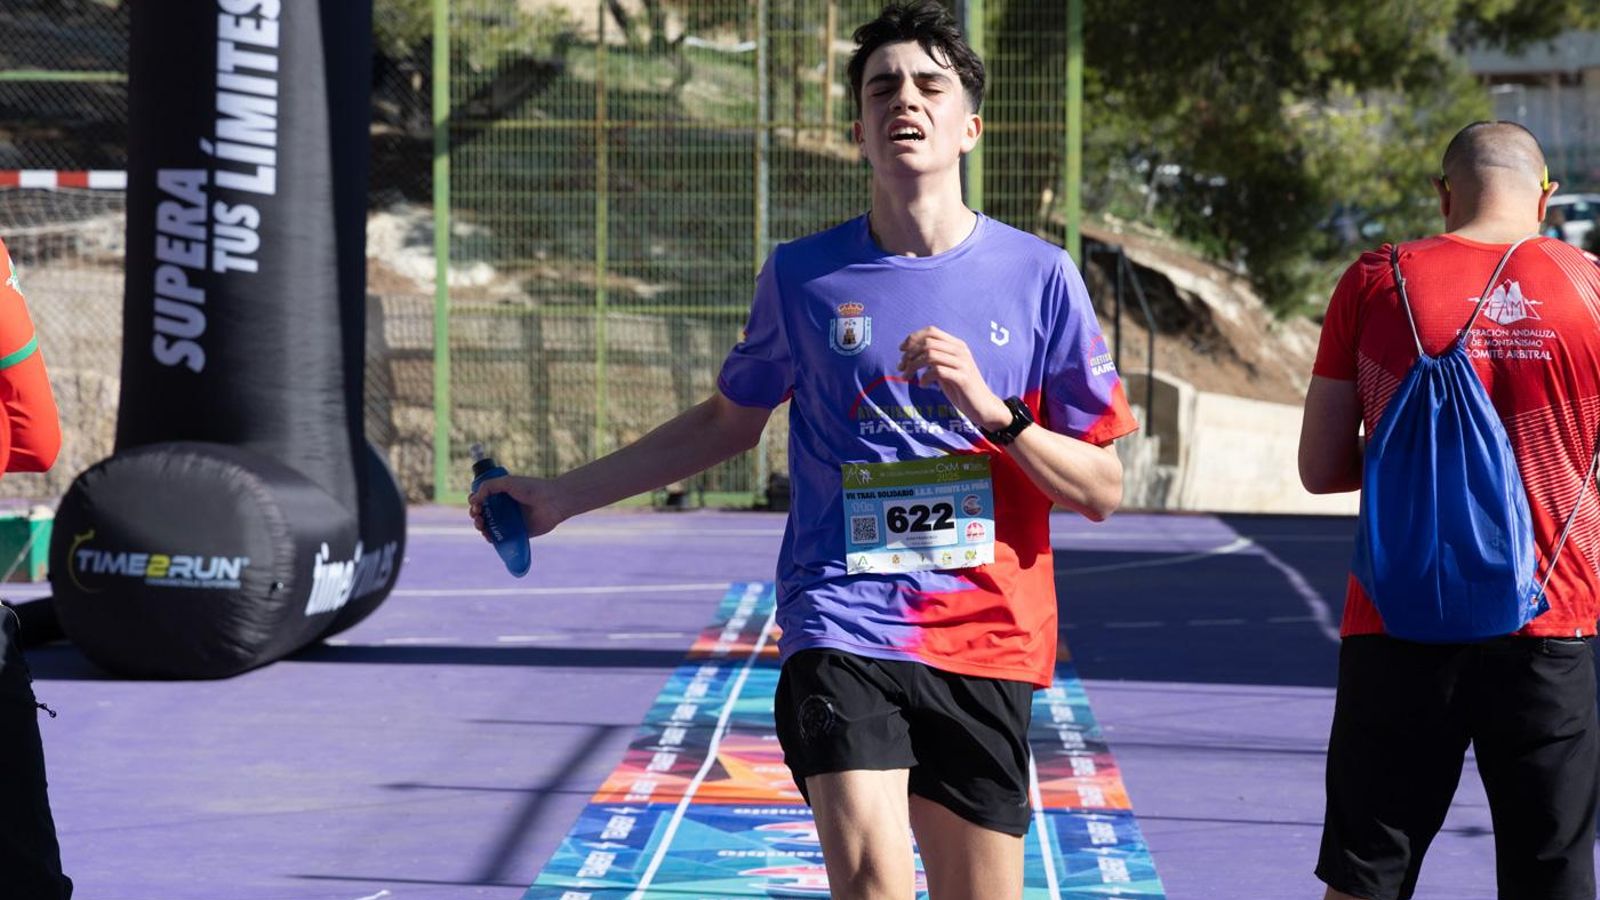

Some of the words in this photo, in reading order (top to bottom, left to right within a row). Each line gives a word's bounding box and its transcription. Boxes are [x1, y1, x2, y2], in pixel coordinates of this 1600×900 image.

[213, 200, 260, 273] TUS
[152, 168, 207, 372] SUPERA
[1489, 300, 1523, 321] FAM
[1456, 328, 1509, 338] FERACIÓN
[1511, 328, 1557, 339] ANDALUZA
[1471, 339, 1482, 347] DE
[1484, 338, 1543, 348] MONTAÑISMO
[1506, 350, 1553, 360] ARBITRAL
[856, 491, 877, 500] TRAIL
[877, 488, 914, 499] SOLIDARIO
[887, 502, 955, 534] 622
[76, 549, 245, 581] TIME2RUN
